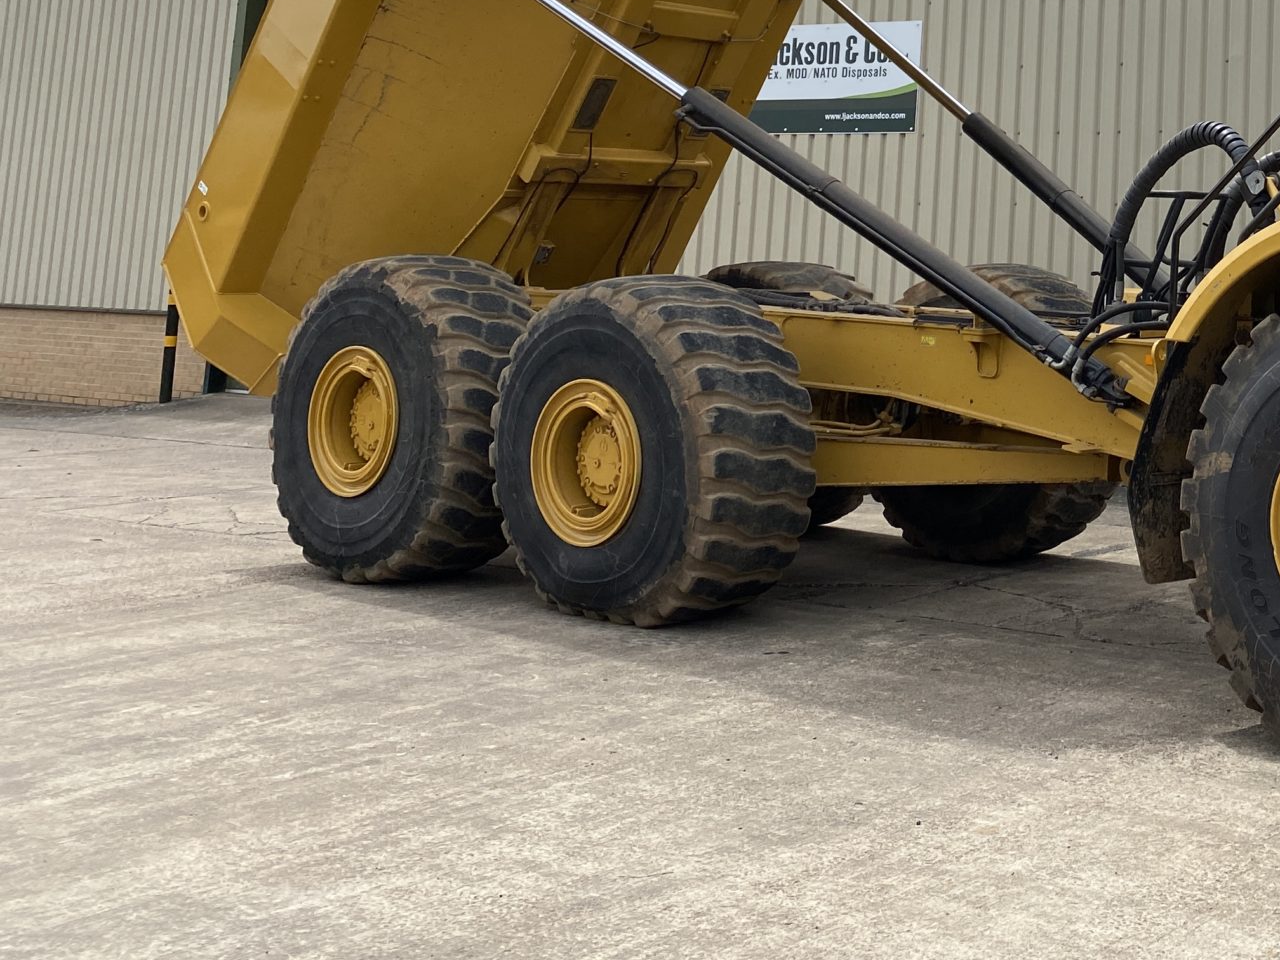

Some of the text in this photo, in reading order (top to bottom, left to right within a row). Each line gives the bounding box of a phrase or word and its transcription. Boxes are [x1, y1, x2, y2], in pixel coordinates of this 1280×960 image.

[772, 38, 840, 66] ckson
[845, 35, 859, 64] &
[768, 66, 887, 79] Ex. MOD/NATO Disposals
